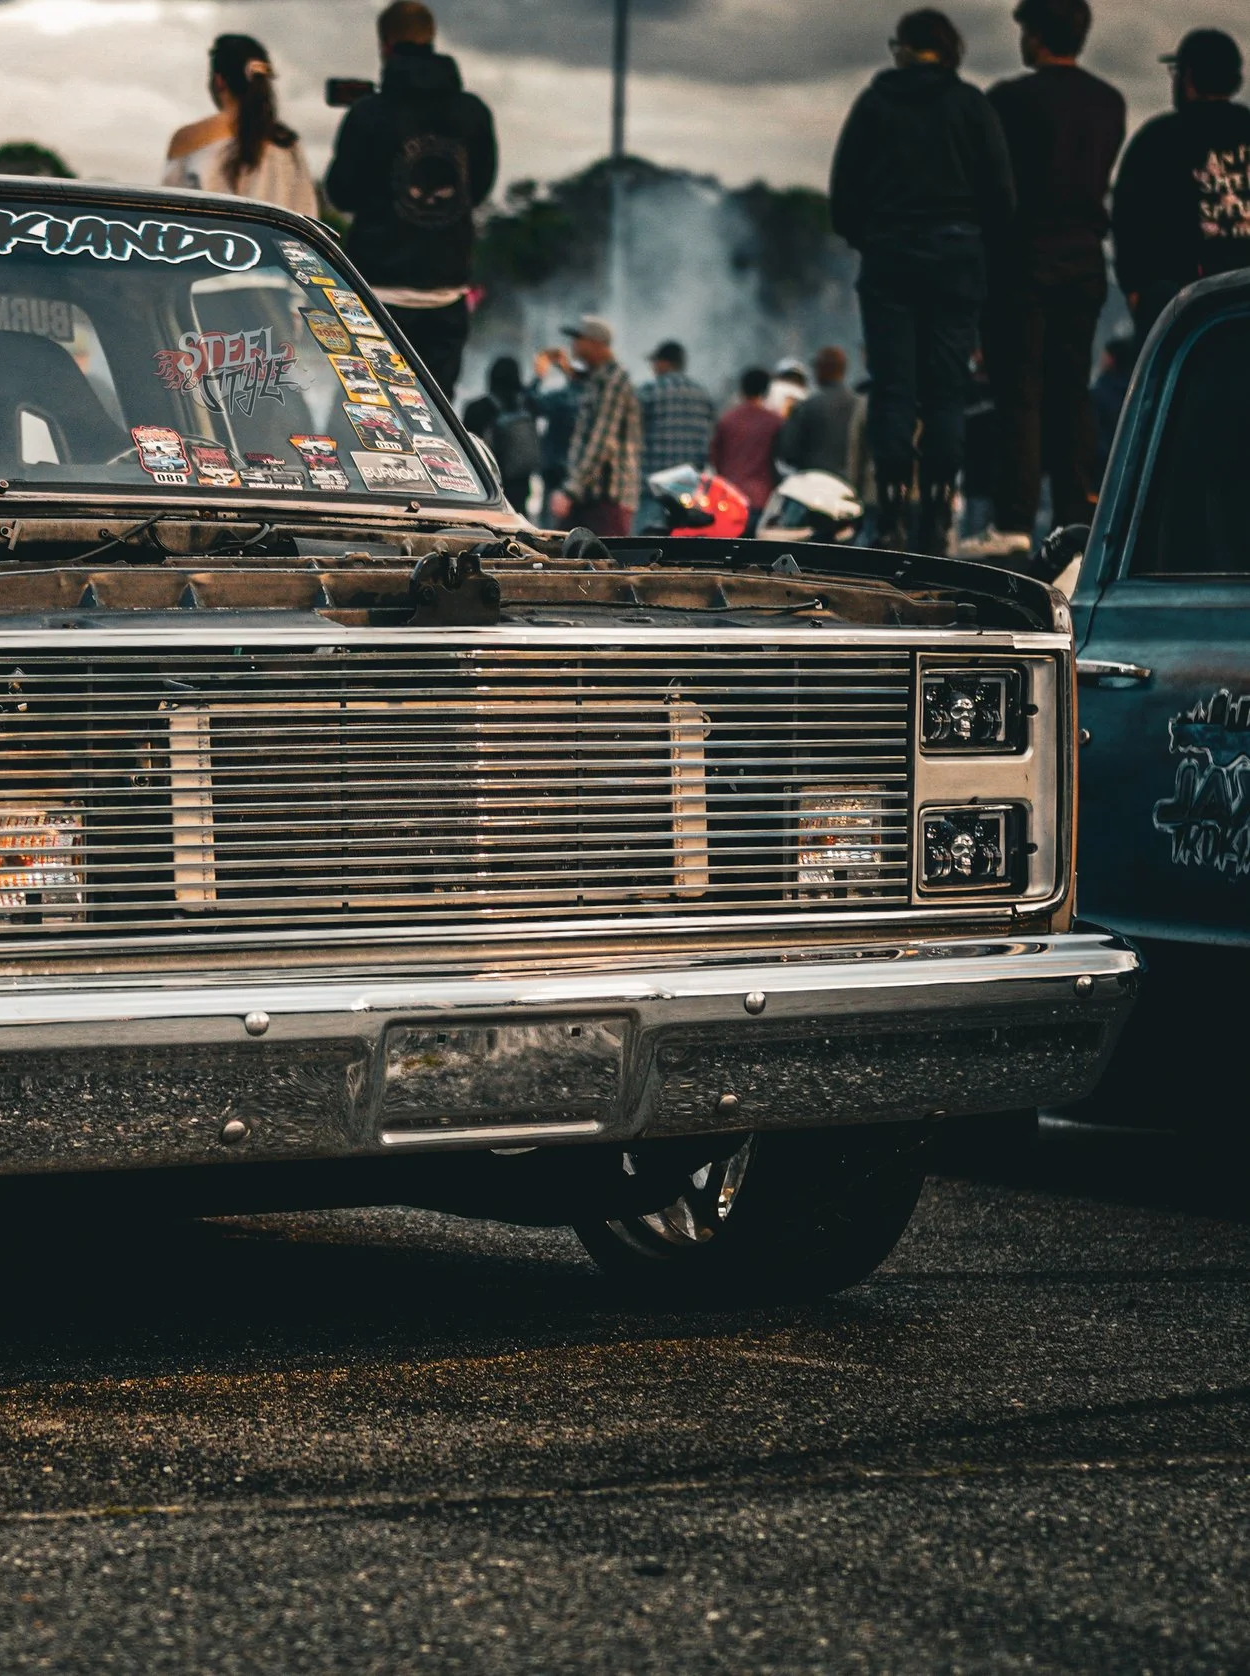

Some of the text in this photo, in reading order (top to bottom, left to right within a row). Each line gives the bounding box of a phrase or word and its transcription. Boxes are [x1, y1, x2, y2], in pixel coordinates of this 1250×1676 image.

[177, 326, 287, 374] STEEL
[181, 368, 198, 391] &
[200, 354, 299, 417] STYLE
[362, 466, 425, 481] BURNOUT
